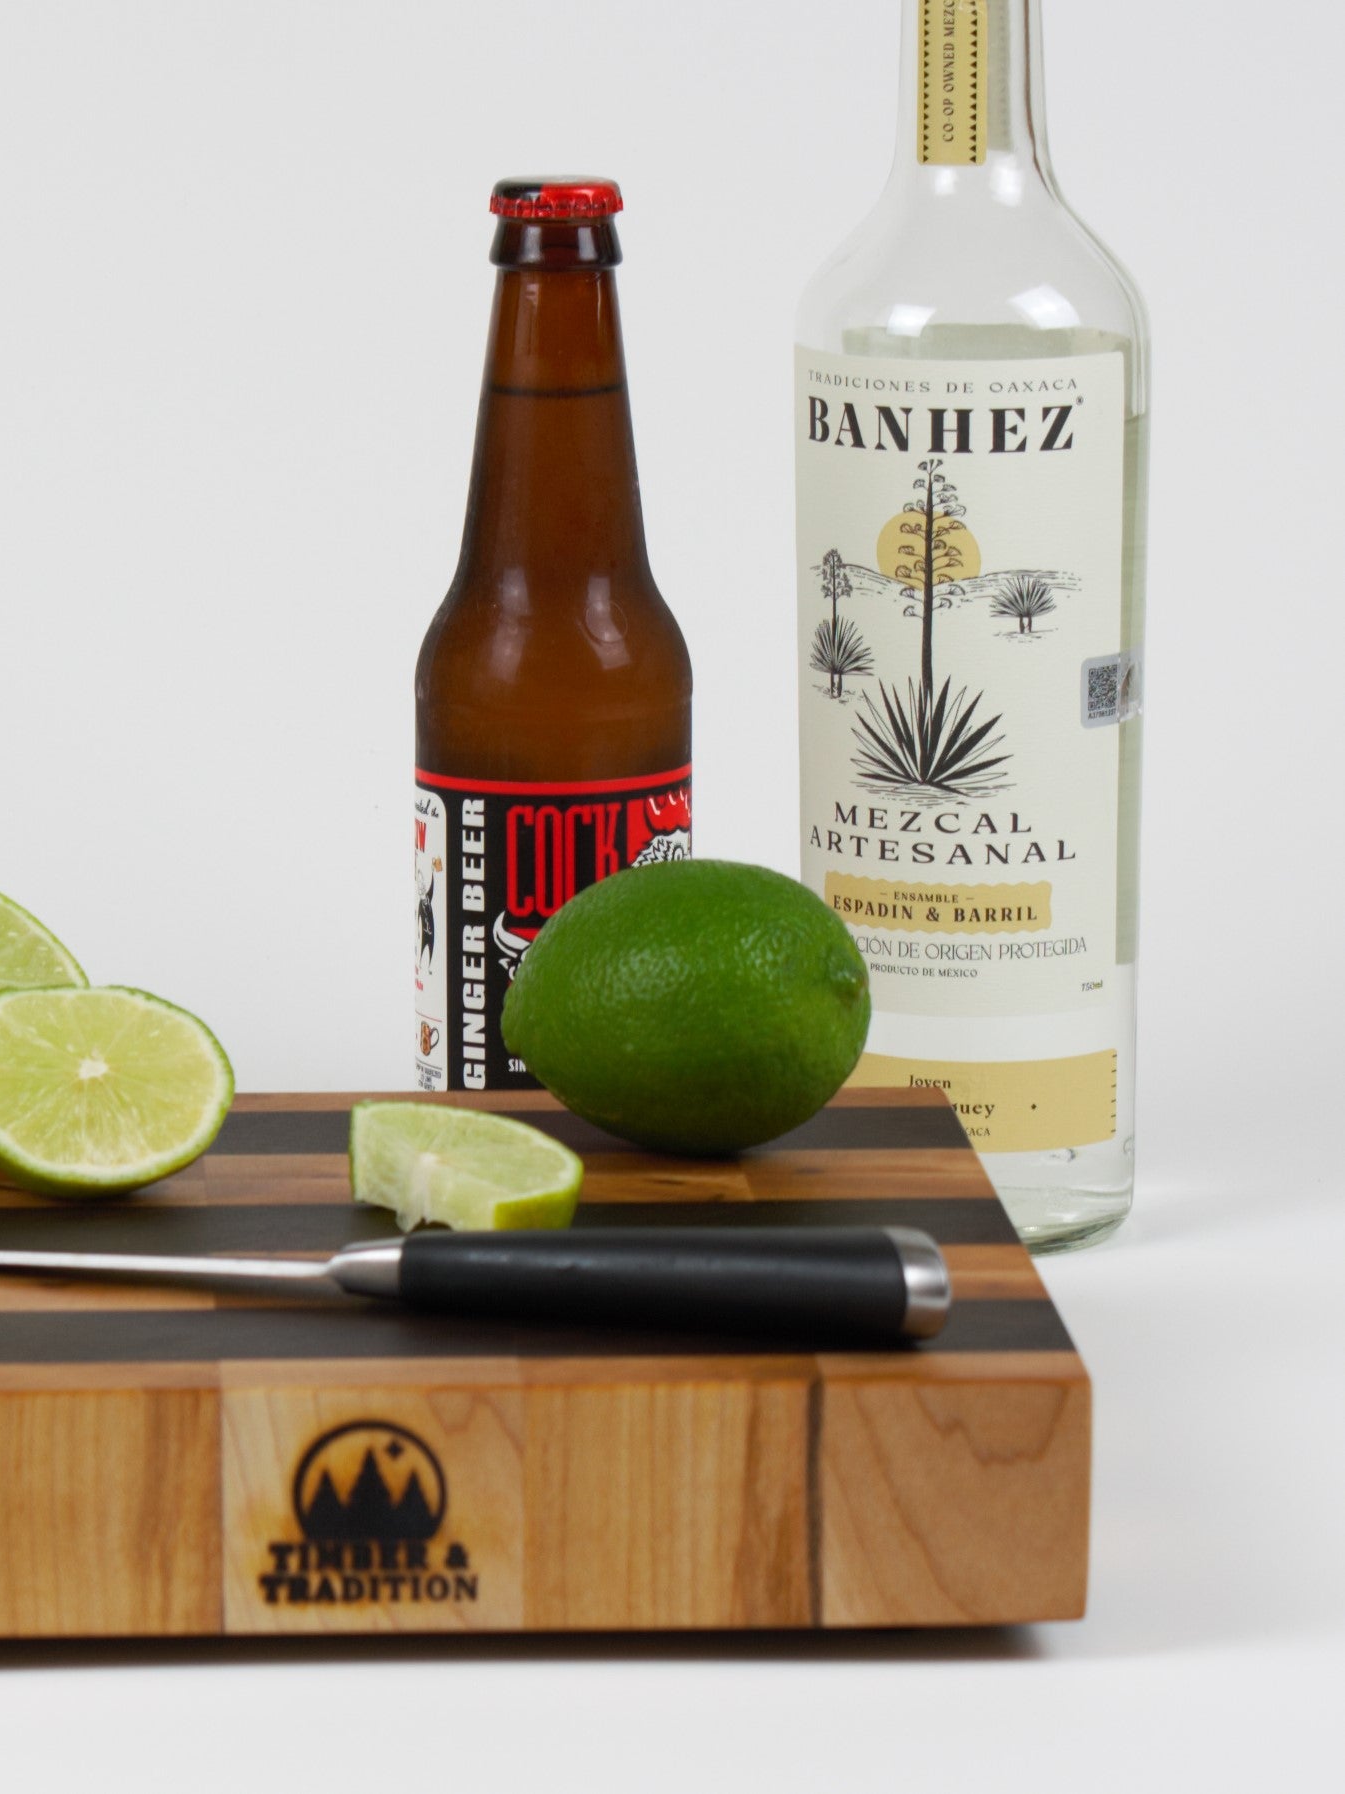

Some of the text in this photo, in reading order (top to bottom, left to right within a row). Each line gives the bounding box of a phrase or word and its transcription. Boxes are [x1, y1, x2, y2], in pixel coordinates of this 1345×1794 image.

[942, 42, 955, 93] OWNED
[942, 98, 954, 143] CO-OP
[808, 369, 1078, 394] TRADICIONES DE OAXACA
[808, 395, 1074, 454] BANHEZ
[834, 801, 1033, 834] MEZCAL
[810, 825, 1076, 865] ARTESANAL
[506, 802, 622, 918] COCK
[833, 894, 1038, 923] ESPADIN & BARRIL
[893, 890, 959, 904] ENSAMBLE
[461, 798, 486, 1090] GINGER BEER
[853, 936, 1087, 961] CIÓN DE ORIGEN PROTEGIDA
[870, 963, 919, 976] PRODUCTO
[922, 966, 935, 977] DE
[508, 1058, 527, 1073] SIN
[909, 1075, 951, 1089] Joven
[953, 1103, 996, 1119] uey
[966, 1127, 991, 1137] ACA
[259, 1573, 478, 1605] TRADITION
